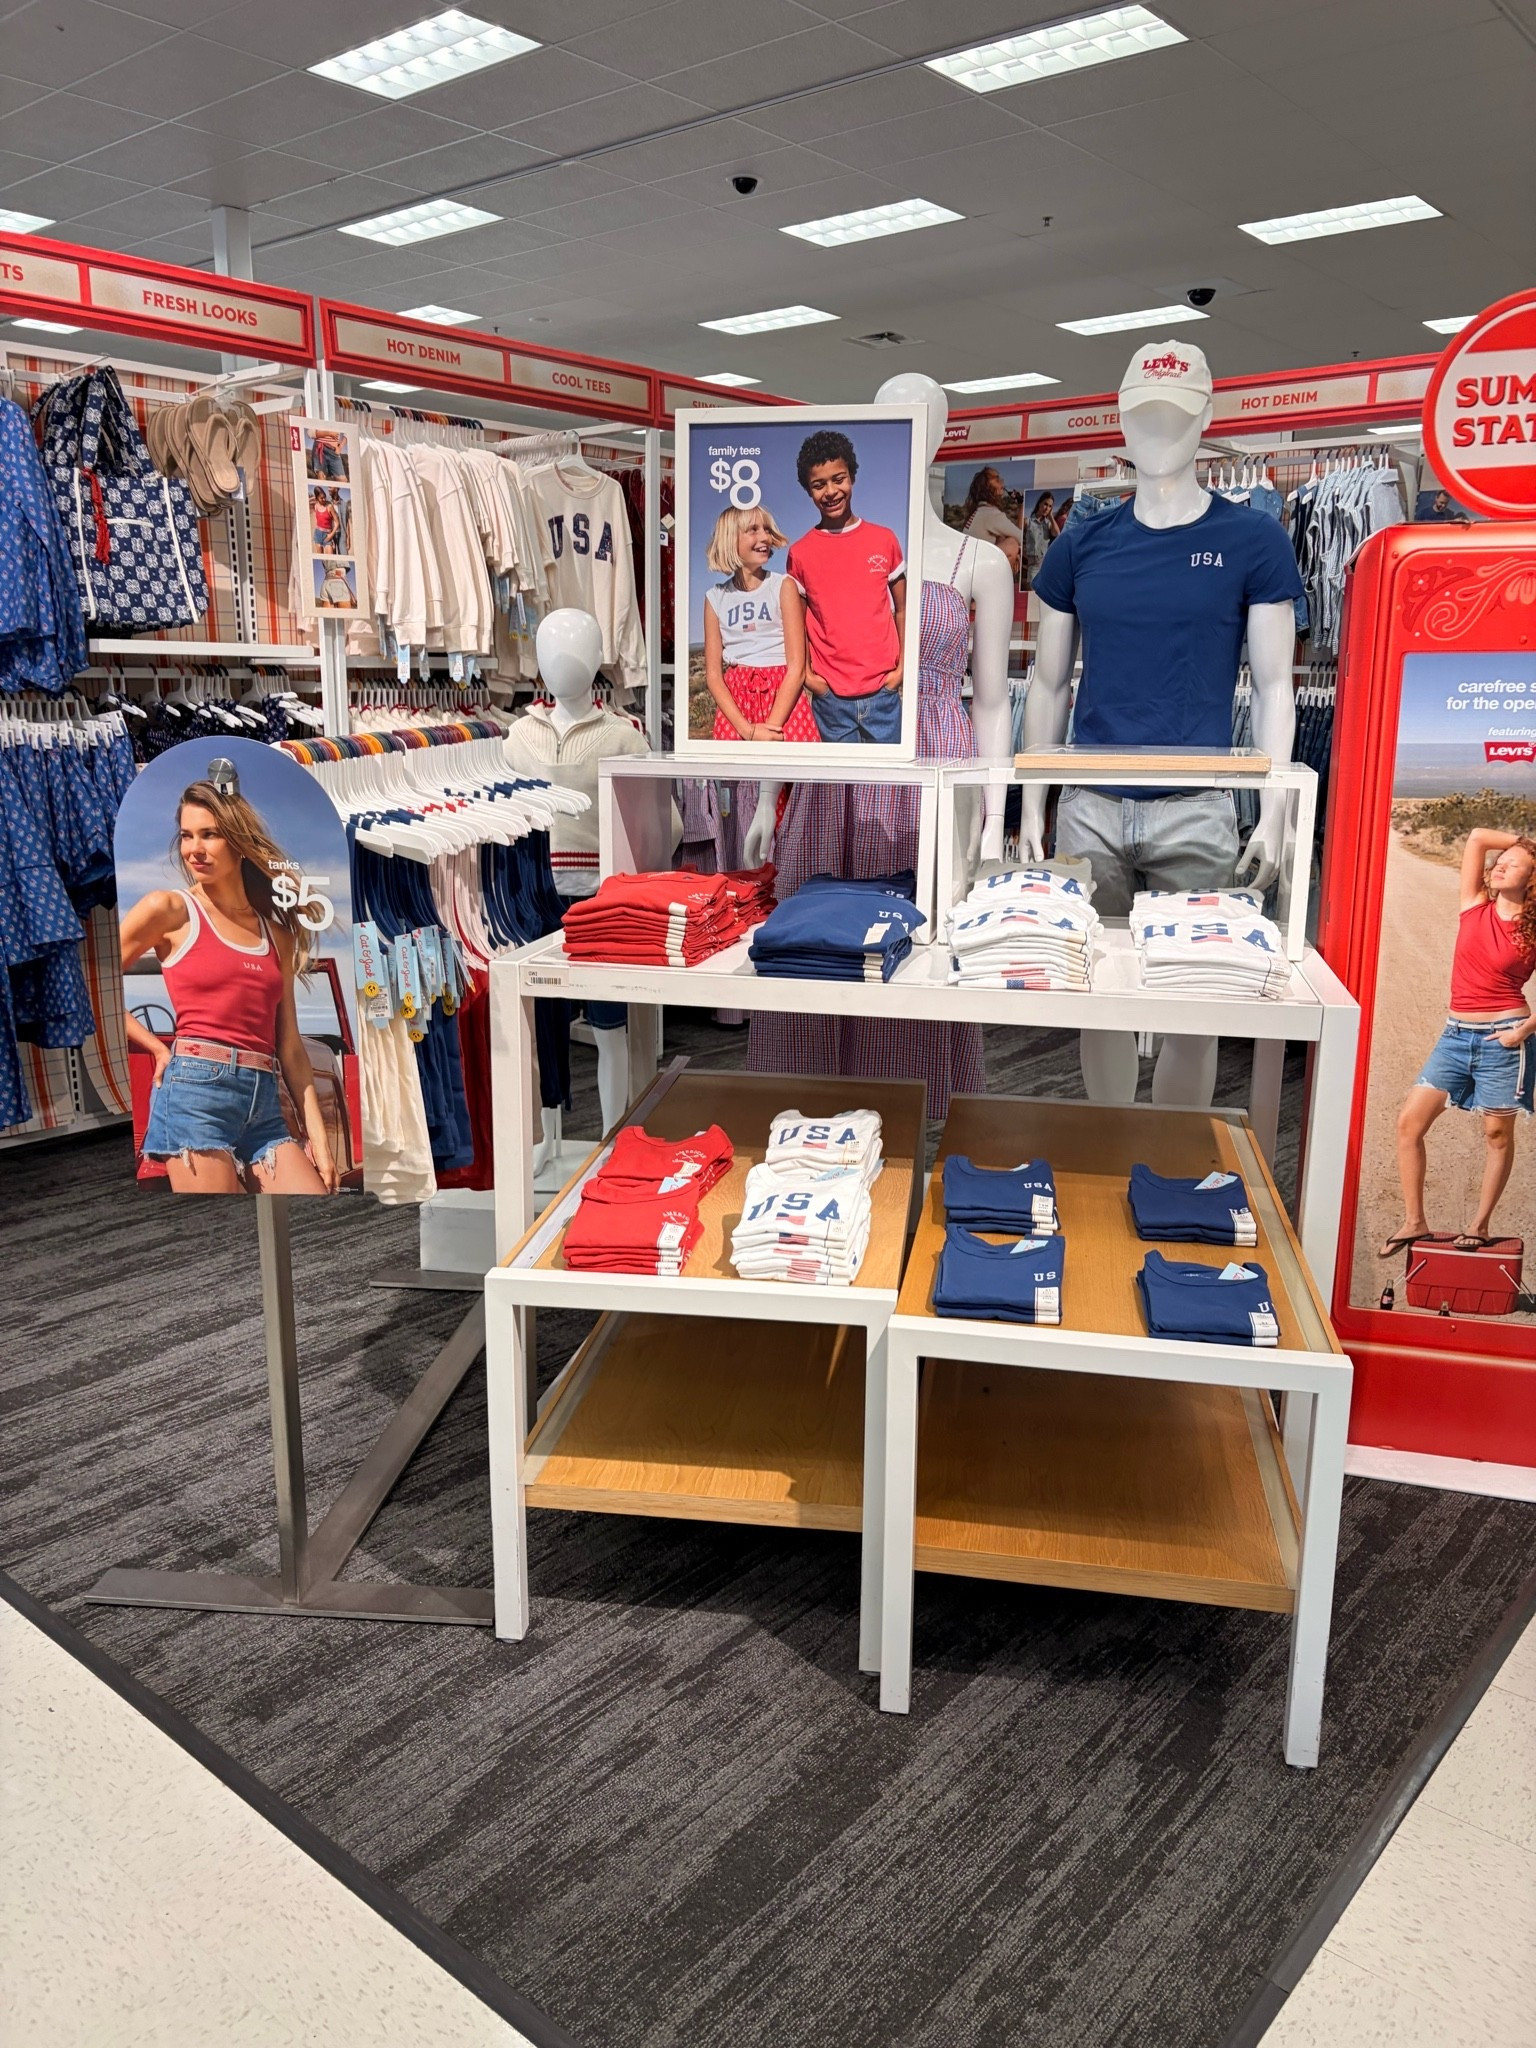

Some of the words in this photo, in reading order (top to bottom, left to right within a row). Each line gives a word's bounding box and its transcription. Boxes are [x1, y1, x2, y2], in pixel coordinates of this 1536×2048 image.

[143, 290, 198, 315] FRESH
[202, 302, 258, 327] LOOKS
[387, 338, 415, 356] HOT
[419, 346, 461, 366] DENIM
[552, 372, 583, 389] COOL
[585, 378, 611, 394] TEES
[1144, 368, 1182, 380] Original
[1241, 396, 1270, 410] HOT
[1272, 390, 1318, 408] DENIM
[1456, 373, 1536, 408] SUM
[1068, 416, 1100, 429] COOL
[708, 445, 738, 457] family
[740, 445, 761, 455] tees
[709, 457, 762, 511] $8
[547, 512, 614, 568] USA
[1190, 551, 1224, 567] USA
[727, 601, 772, 627] USA
[1458, 679, 1527, 693] carefree
[1446, 696, 1470, 710] for
[1472, 696, 1500, 710] the
[1503, 699, 1536, 713] ope
[1488, 727, 1536, 738] featuring
[268, 859, 300, 871] tanks
[271, 872, 335, 931] $5
[360, 935, 369, 949] Cat
[1143, 922, 1276, 953] USA
[243, 961, 263, 972] USA
[359, 958, 375, 979] Jack
[778, 1125, 857, 1145] USA
[1023, 1182, 1053, 1192] USA
[747, 1192, 840, 1221] USA
